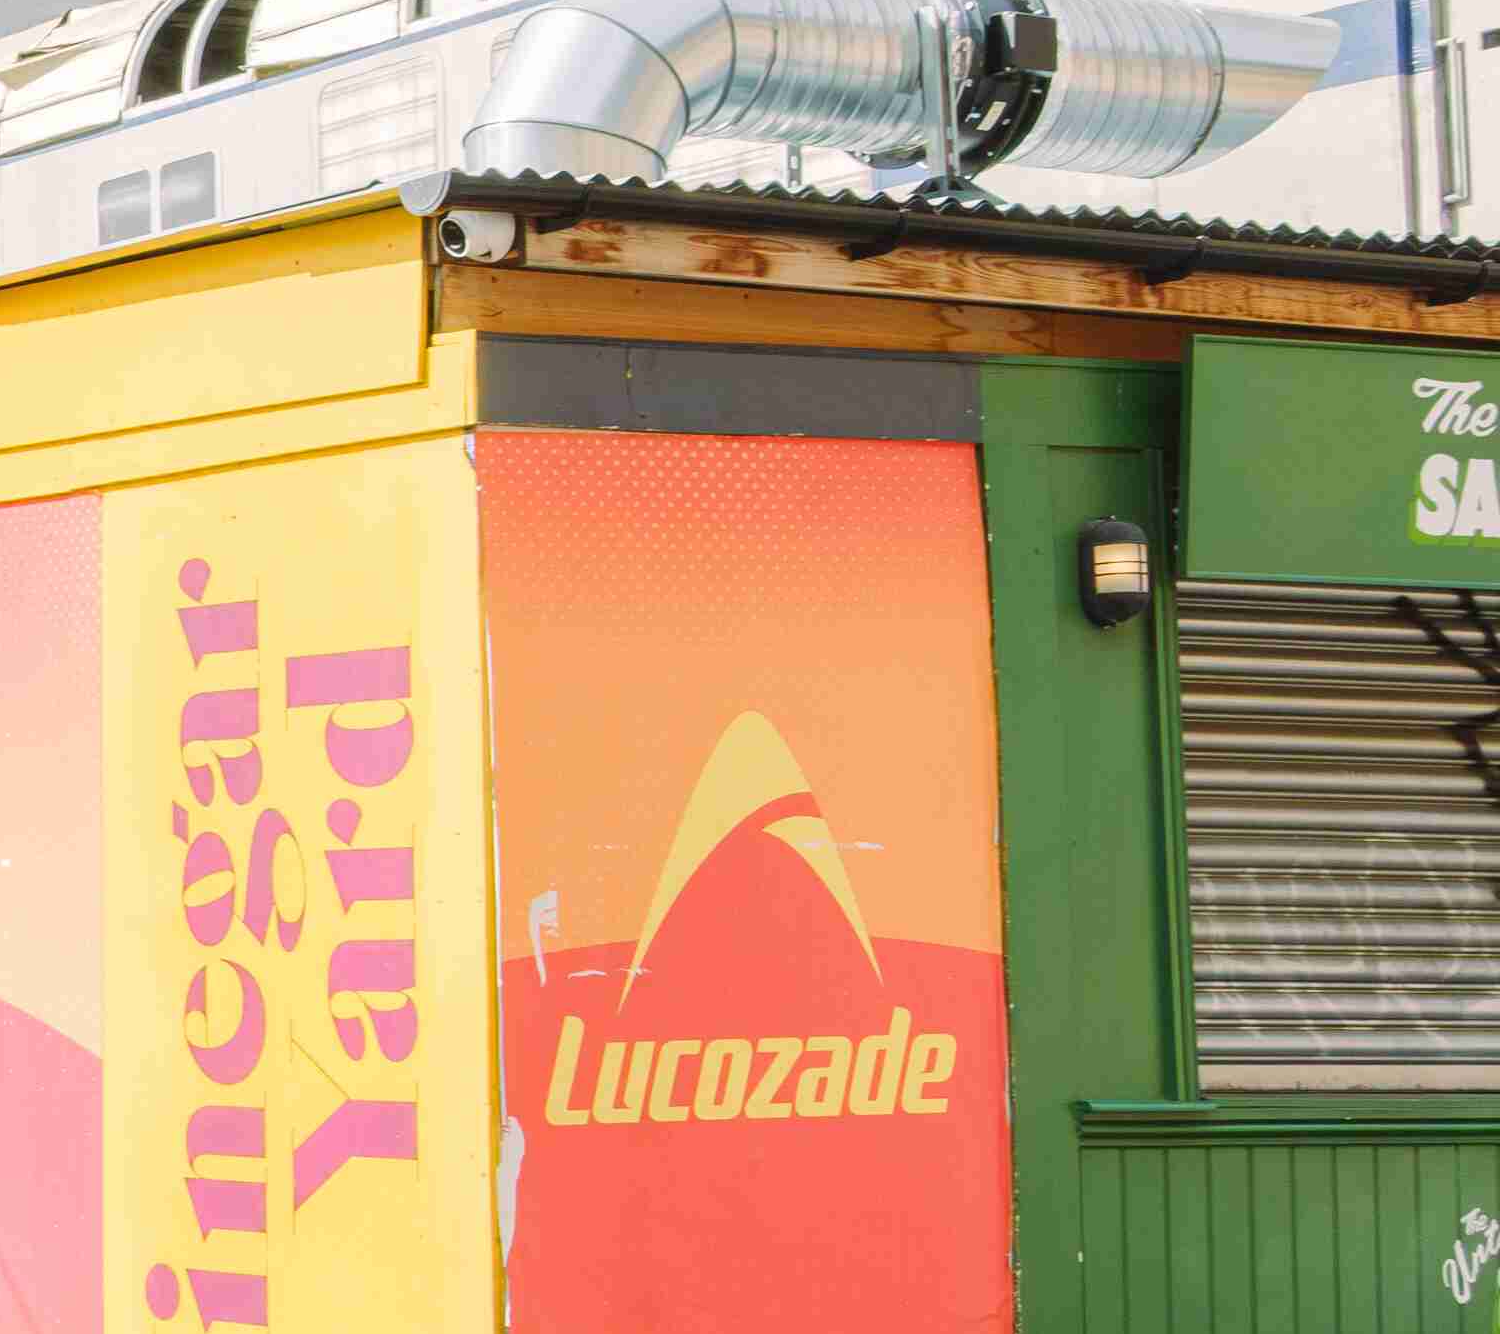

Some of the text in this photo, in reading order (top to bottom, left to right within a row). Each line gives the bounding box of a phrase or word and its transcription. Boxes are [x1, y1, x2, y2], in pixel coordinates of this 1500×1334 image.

[1412, 378, 1500, 437] The
[285, 630, 420, 1234] Yard
[545, 1006, 957, 1126] Lucozade
